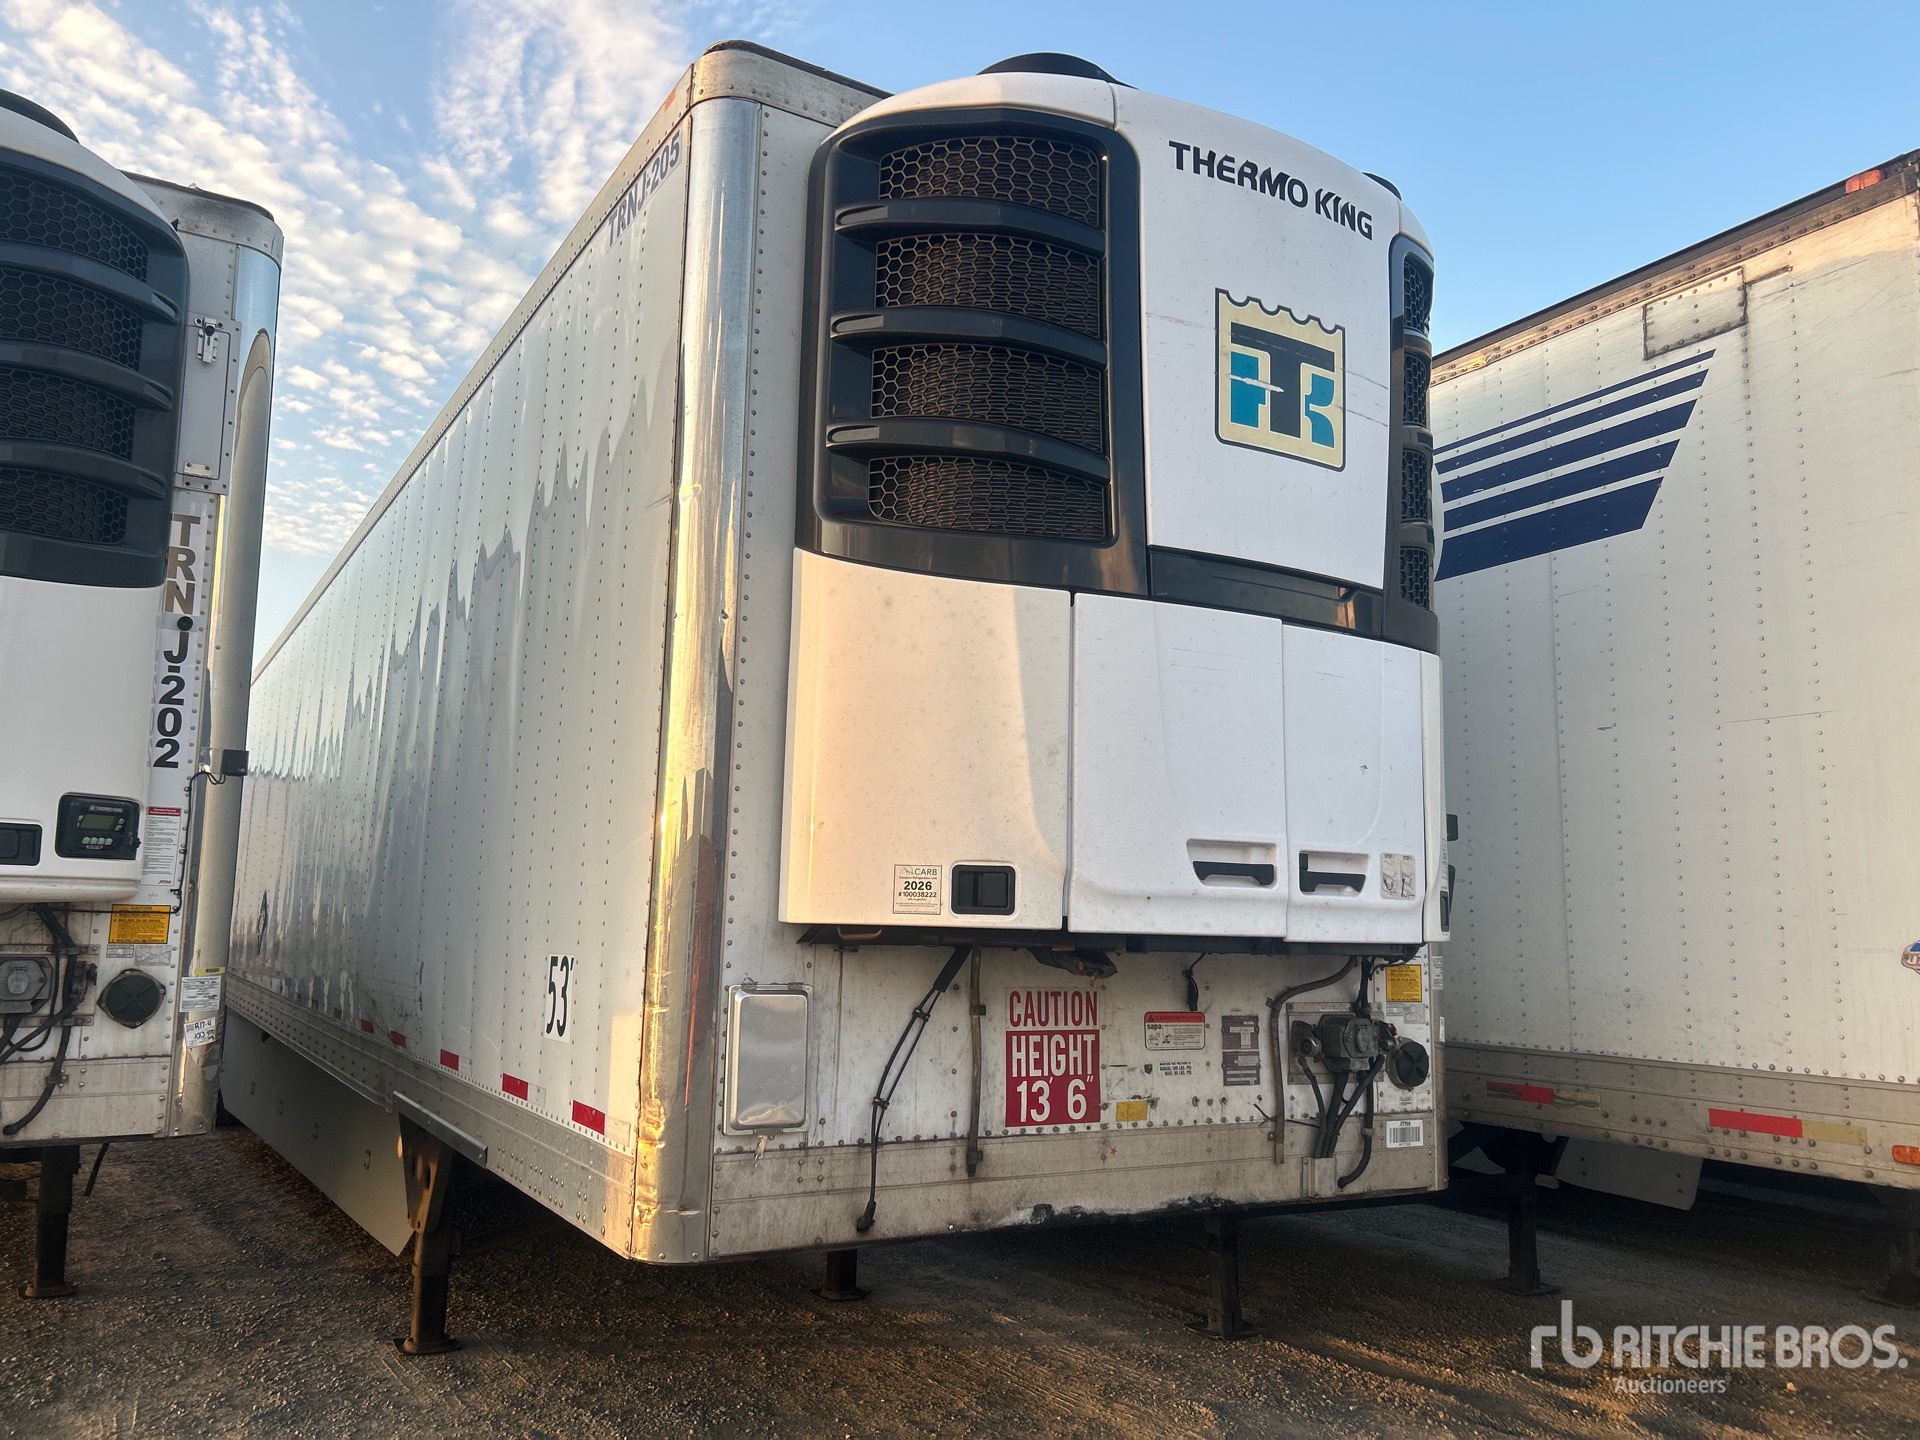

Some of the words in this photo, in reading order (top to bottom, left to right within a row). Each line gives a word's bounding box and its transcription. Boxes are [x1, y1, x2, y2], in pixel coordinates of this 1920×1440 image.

[608, 130, 681, 247] TRNJ-205
[1168, 140, 1309, 209] THERMO
[1315, 188, 1373, 241] KING
[904, 881, 932, 891] 2026
[914, 868, 938, 876] CARB
[546, 955, 574, 1037] 53'
[1009, 991, 1098, 1027] CAUTION
[1012, 1034, 1095, 1077] HEIGHT
